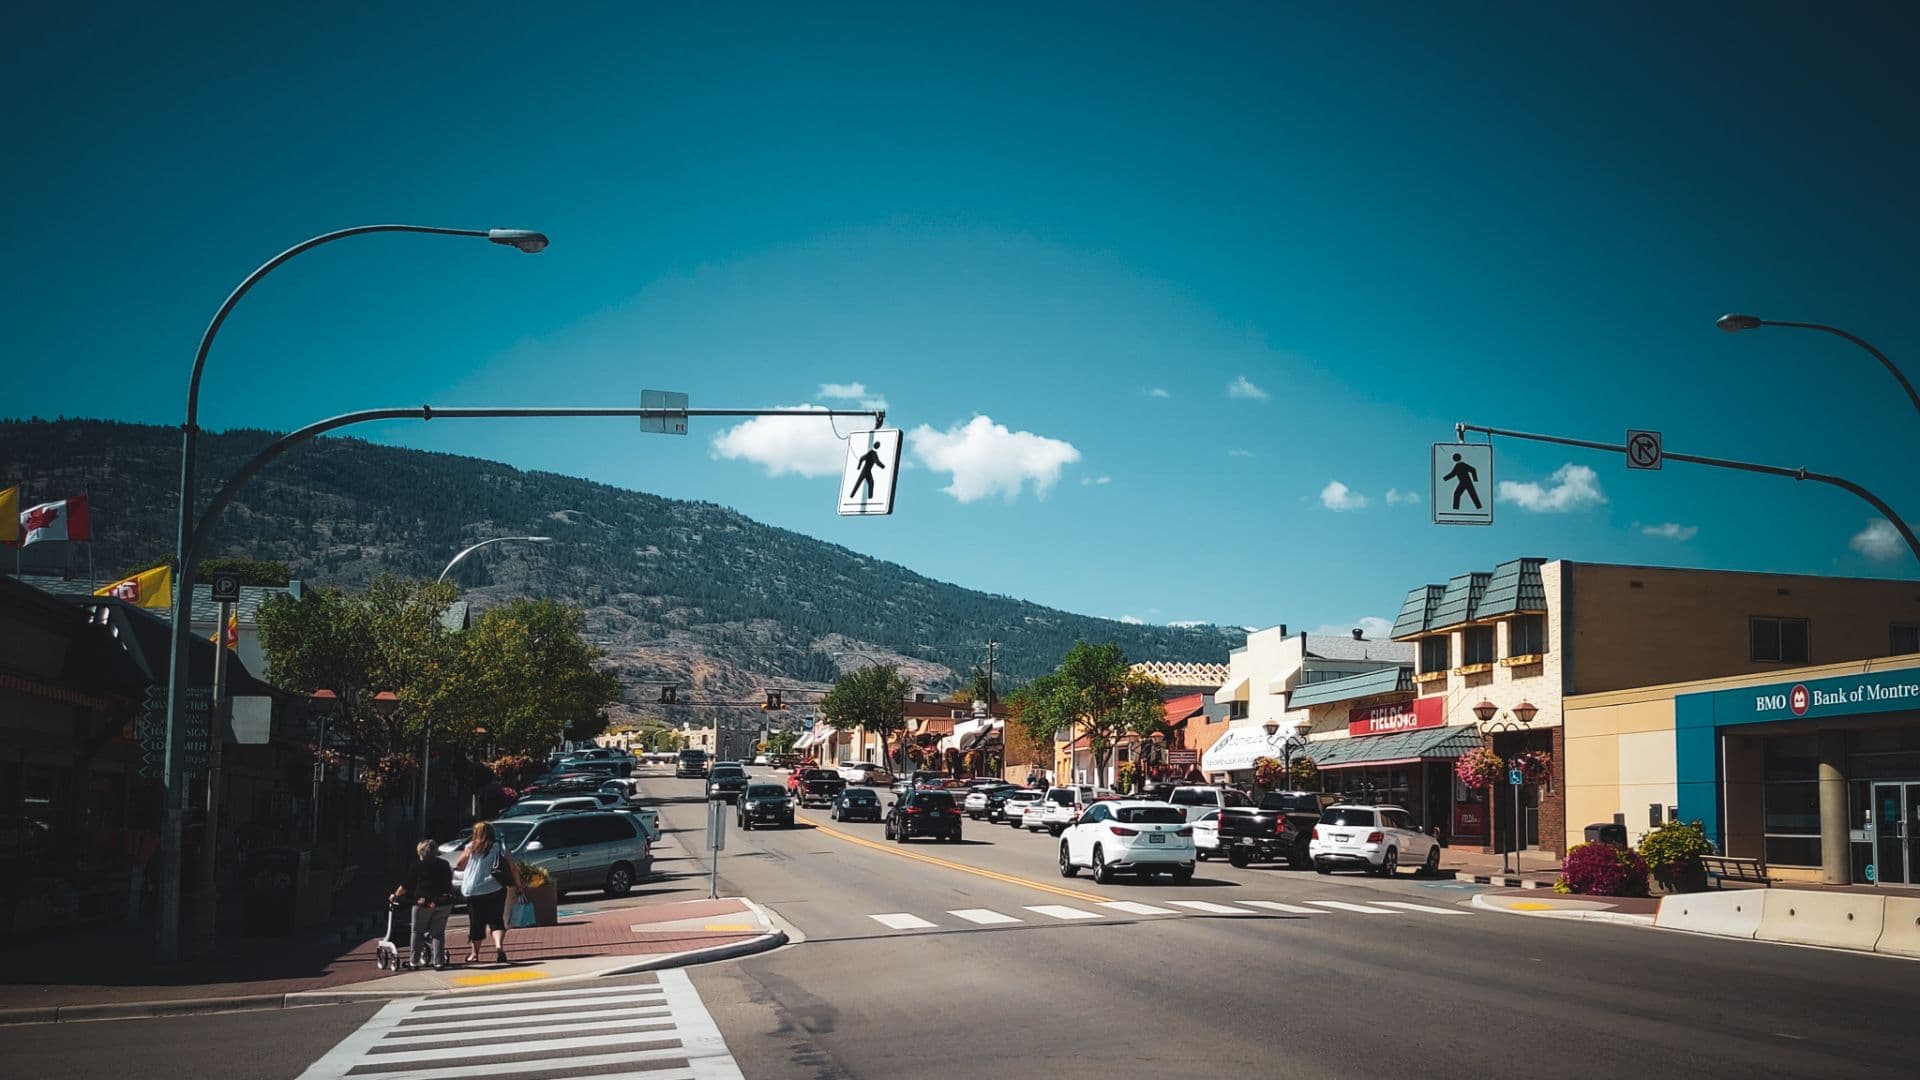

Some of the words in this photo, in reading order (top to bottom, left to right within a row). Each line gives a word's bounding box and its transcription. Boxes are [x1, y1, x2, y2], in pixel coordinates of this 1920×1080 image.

[1756, 694, 1786, 711] BMO
[1813, 688, 1847, 706] Bank
[1850, 685, 1864, 702] of
